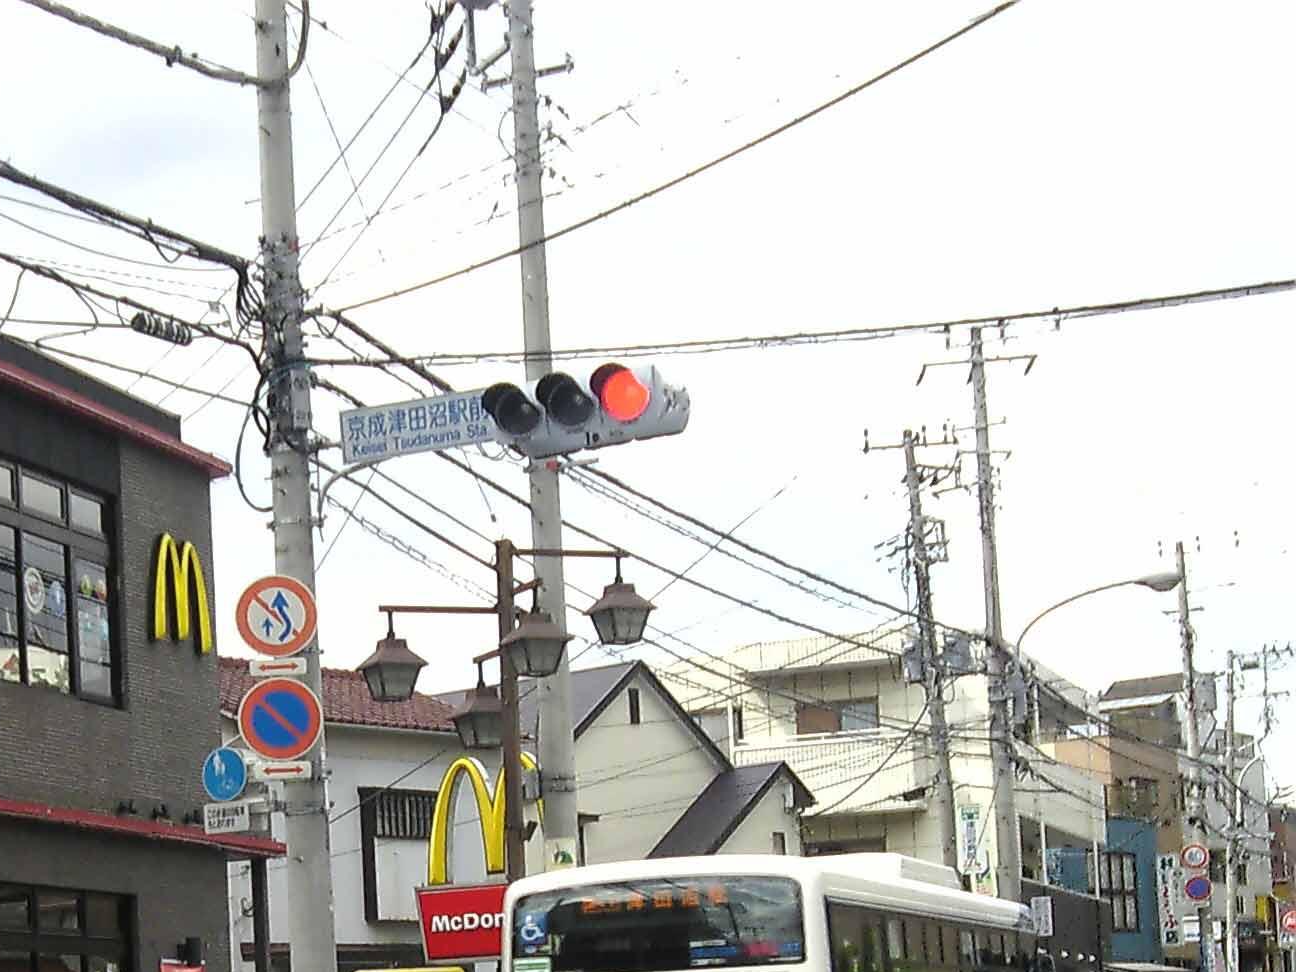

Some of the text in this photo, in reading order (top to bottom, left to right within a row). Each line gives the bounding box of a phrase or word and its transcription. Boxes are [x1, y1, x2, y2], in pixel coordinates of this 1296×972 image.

[348, 396, 489, 441] 京成津田沼駅前
[432, 912, 506, 933] McDon
